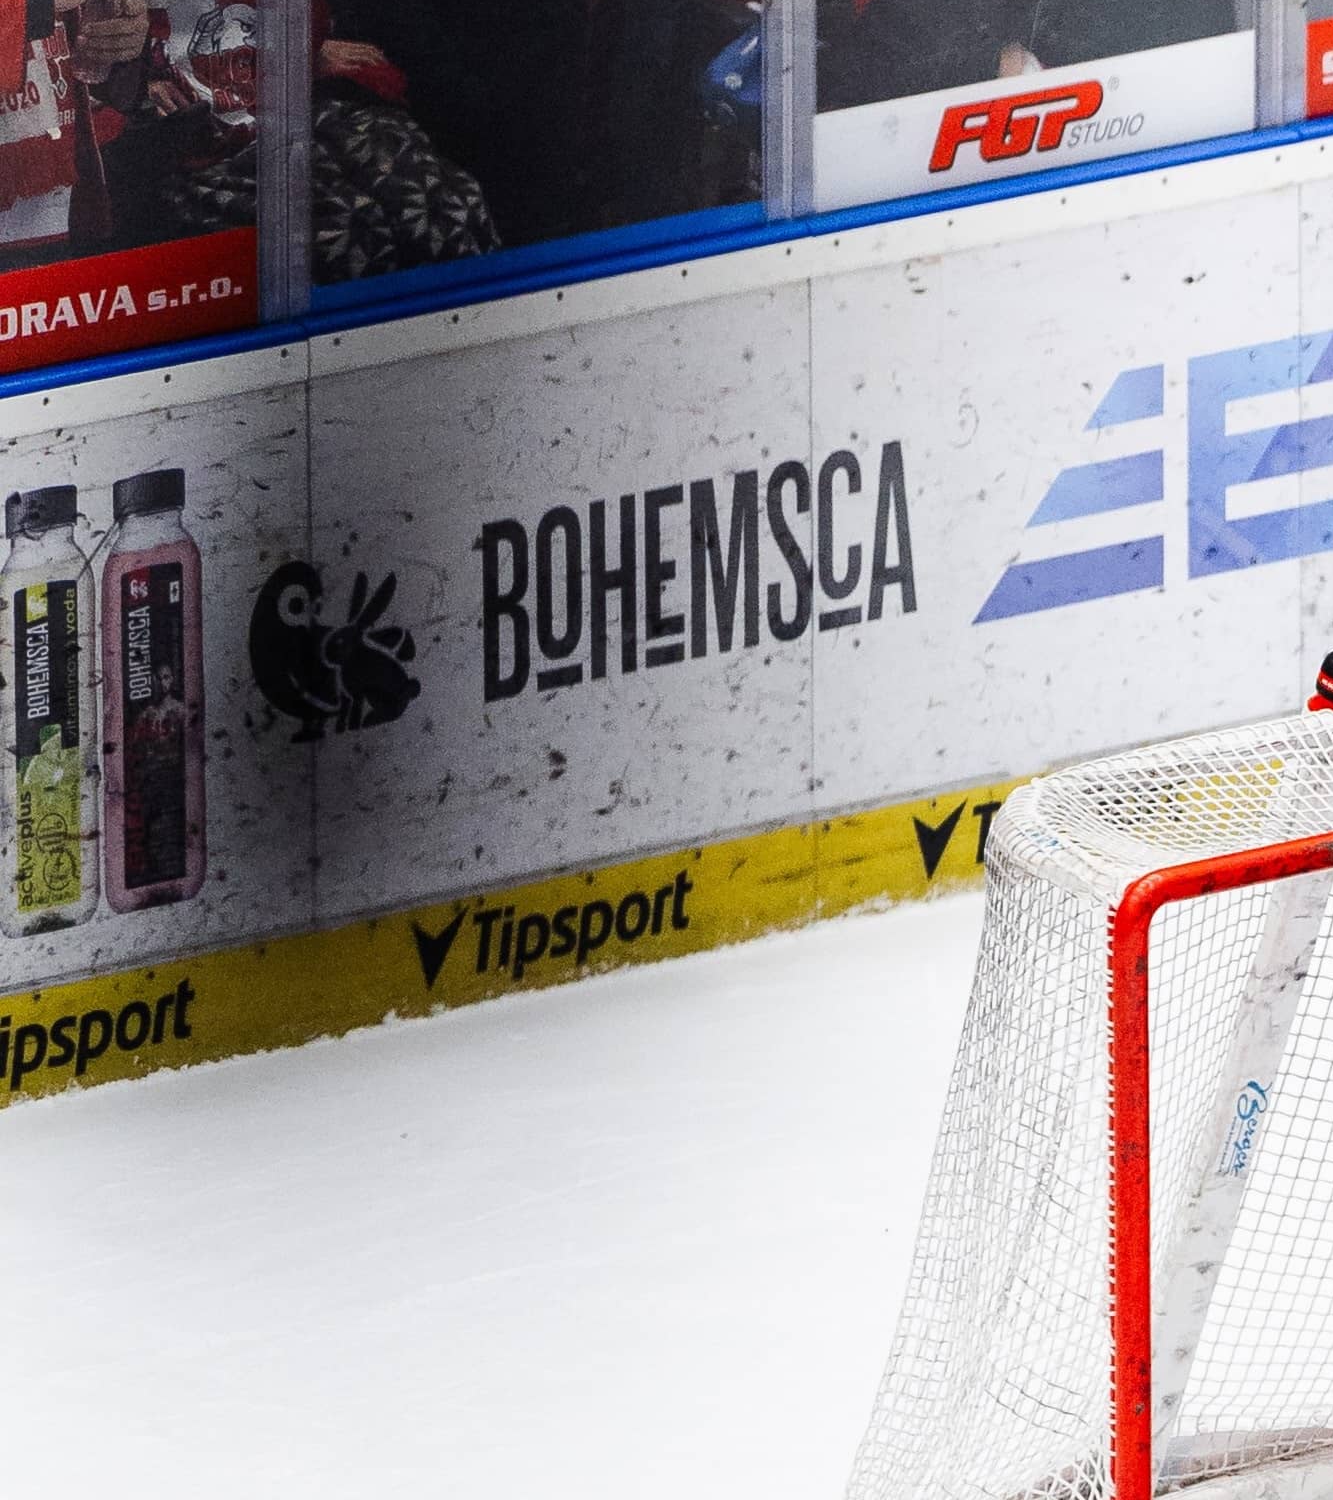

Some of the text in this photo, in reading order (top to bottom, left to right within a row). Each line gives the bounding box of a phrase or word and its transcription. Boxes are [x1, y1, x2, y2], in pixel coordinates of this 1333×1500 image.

[1067, 113, 1145, 149] STUDIO
[147, 276, 243, 312] s.r.o.
[481, 439, 918, 702] BOHEMSCA
[26, 621, 50, 720] BOHEMSCA
[473, 868, 695, 982] Tipsport
